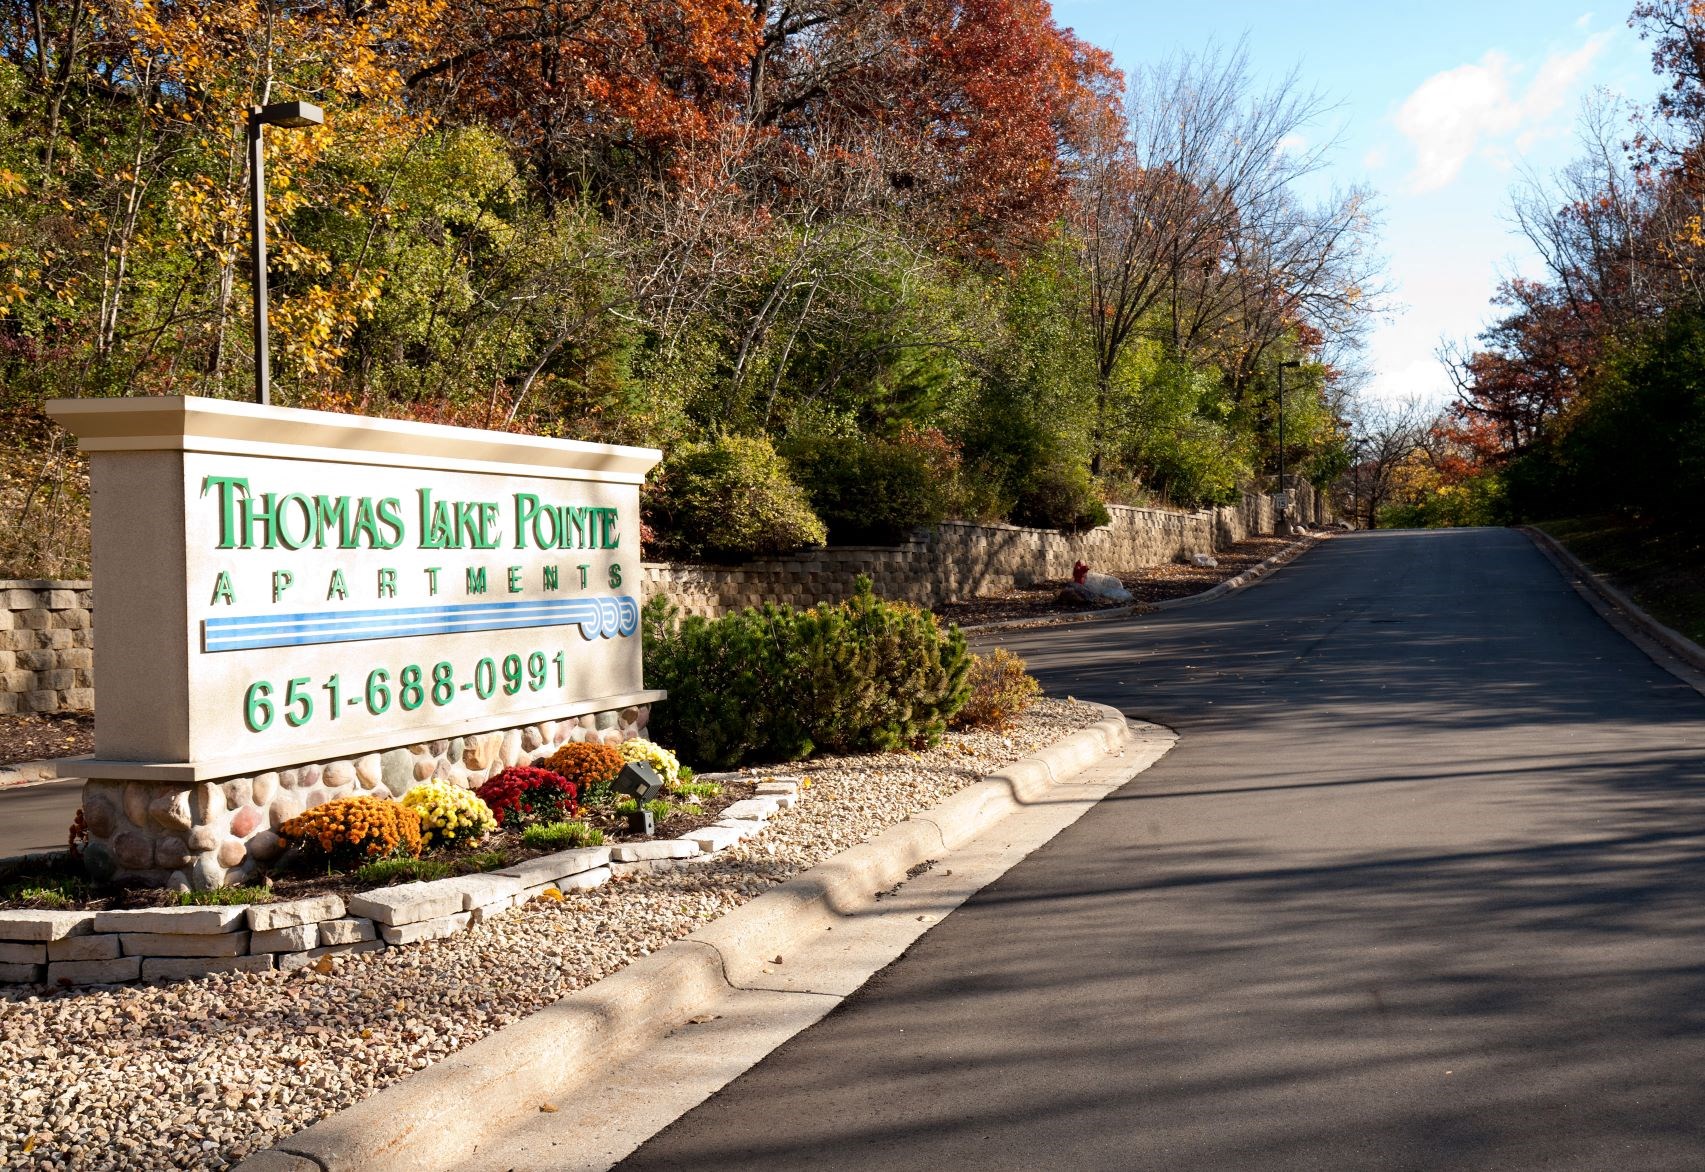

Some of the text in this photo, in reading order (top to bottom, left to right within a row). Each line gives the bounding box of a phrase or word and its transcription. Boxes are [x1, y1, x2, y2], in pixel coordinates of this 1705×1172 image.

[202, 475, 620, 550] THOMAS LAKE POINTE
[211, 563, 622, 605] APARTMENTS
[245, 650, 564, 731] 651-688-0991
